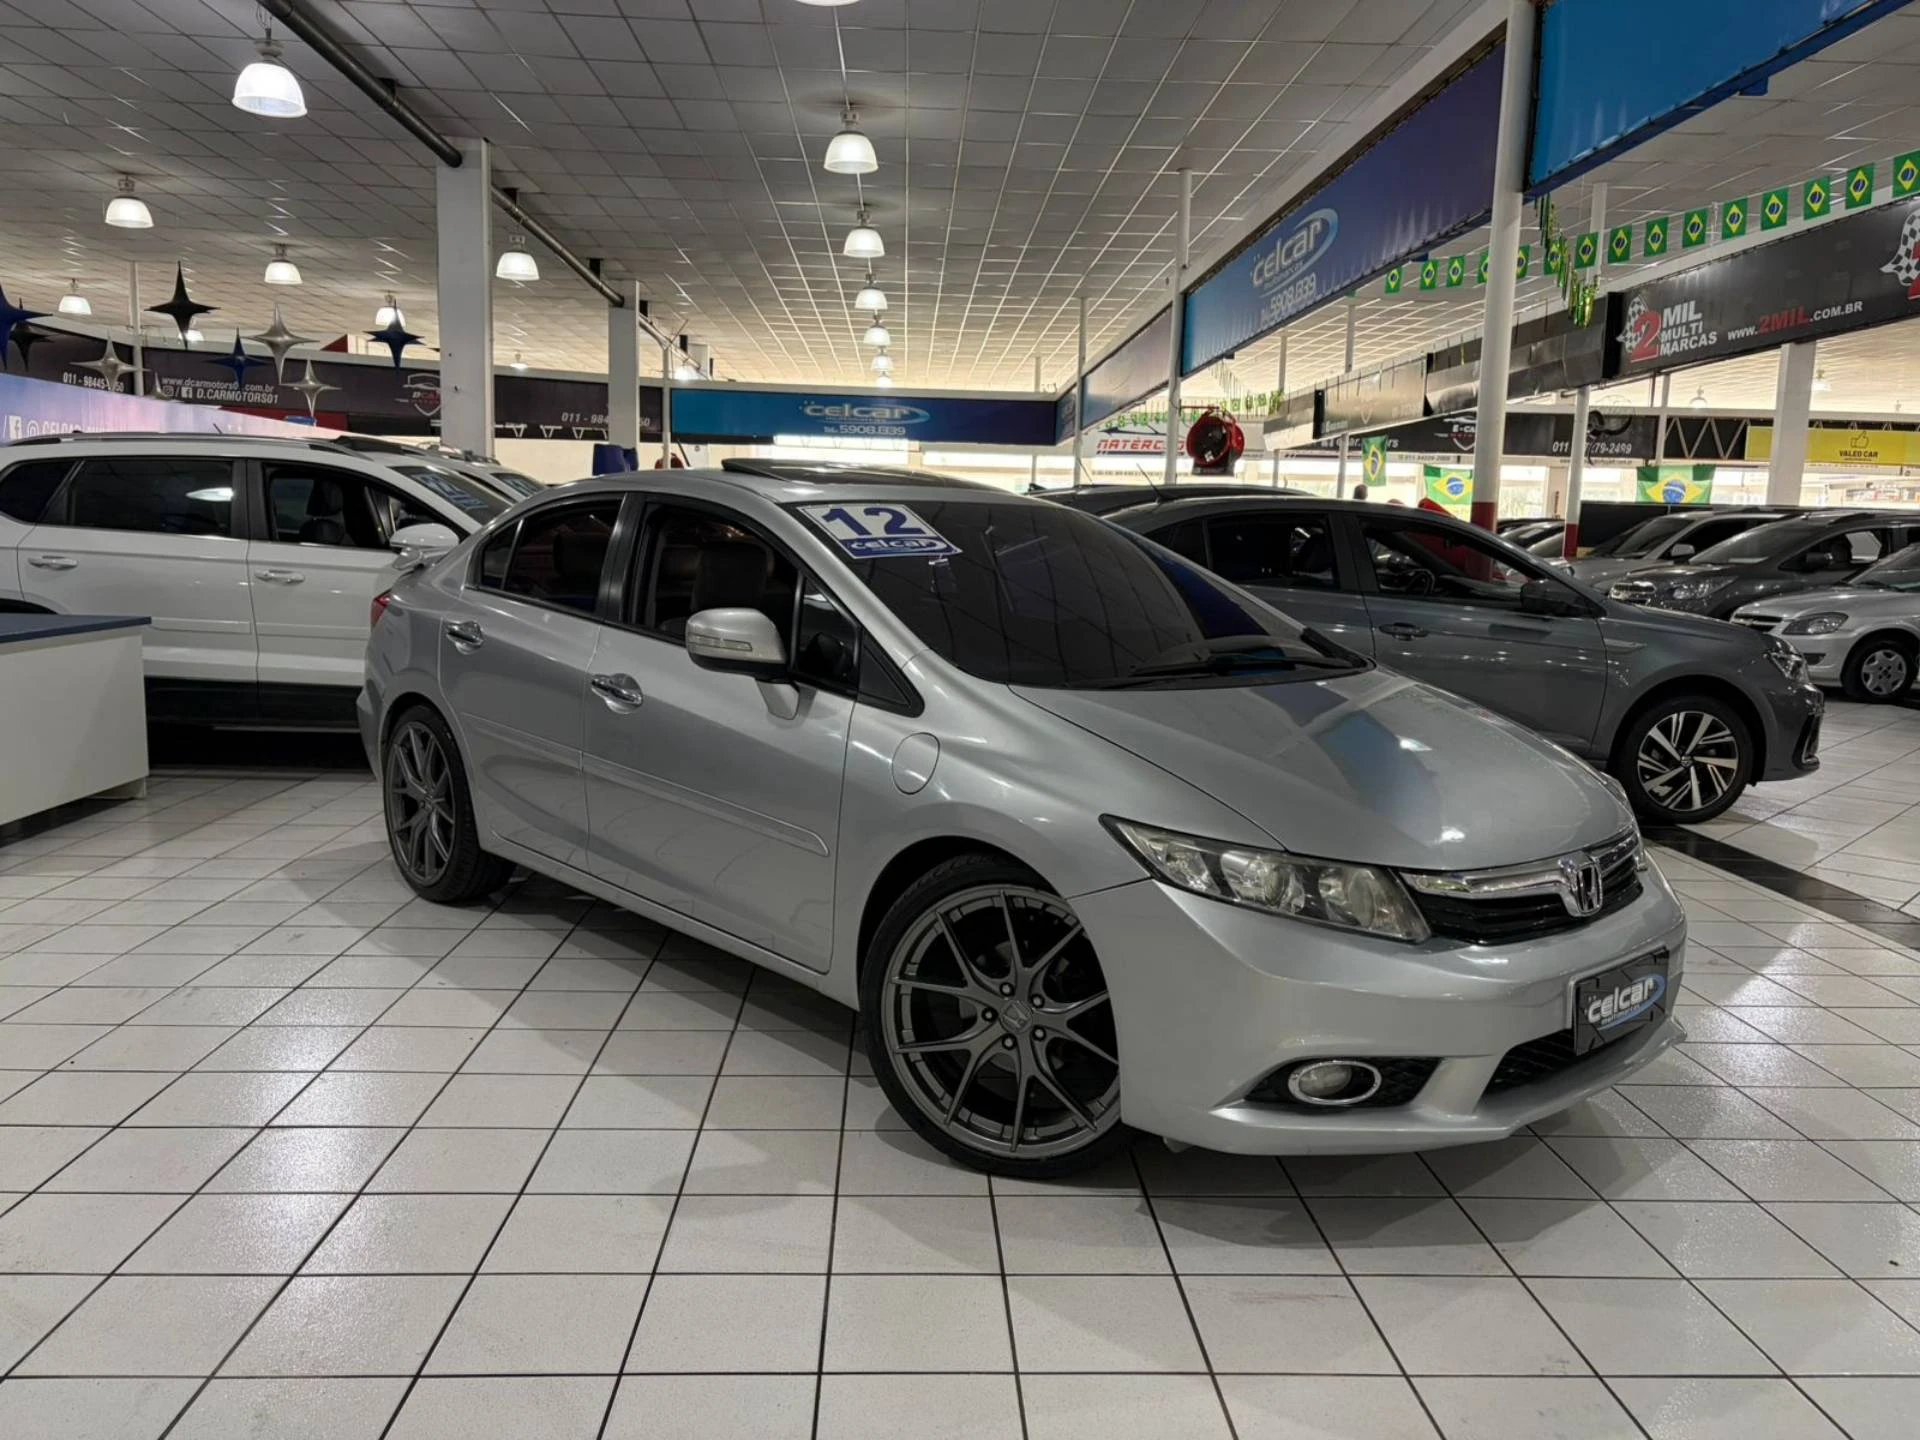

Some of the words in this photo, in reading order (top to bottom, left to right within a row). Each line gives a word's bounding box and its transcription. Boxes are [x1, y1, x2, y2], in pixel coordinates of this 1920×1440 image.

[1253, 220, 1321, 288] celcar
[1662, 300, 1703, 328] MIL
[1662, 322, 1703, 342] MULTI
[1660, 331, 1718, 356] MARCAS
[63, 371, 77, 385] 011
[196, 388, 279, 405] D.CARMOTORS01
[561, 412, 581, 423] 011
[805, 403, 910, 419] celcar
[1552, 441, 1569, 452] 011
[822, 507, 926, 535] 12
[1588, 978, 1655, 1023] celcar
